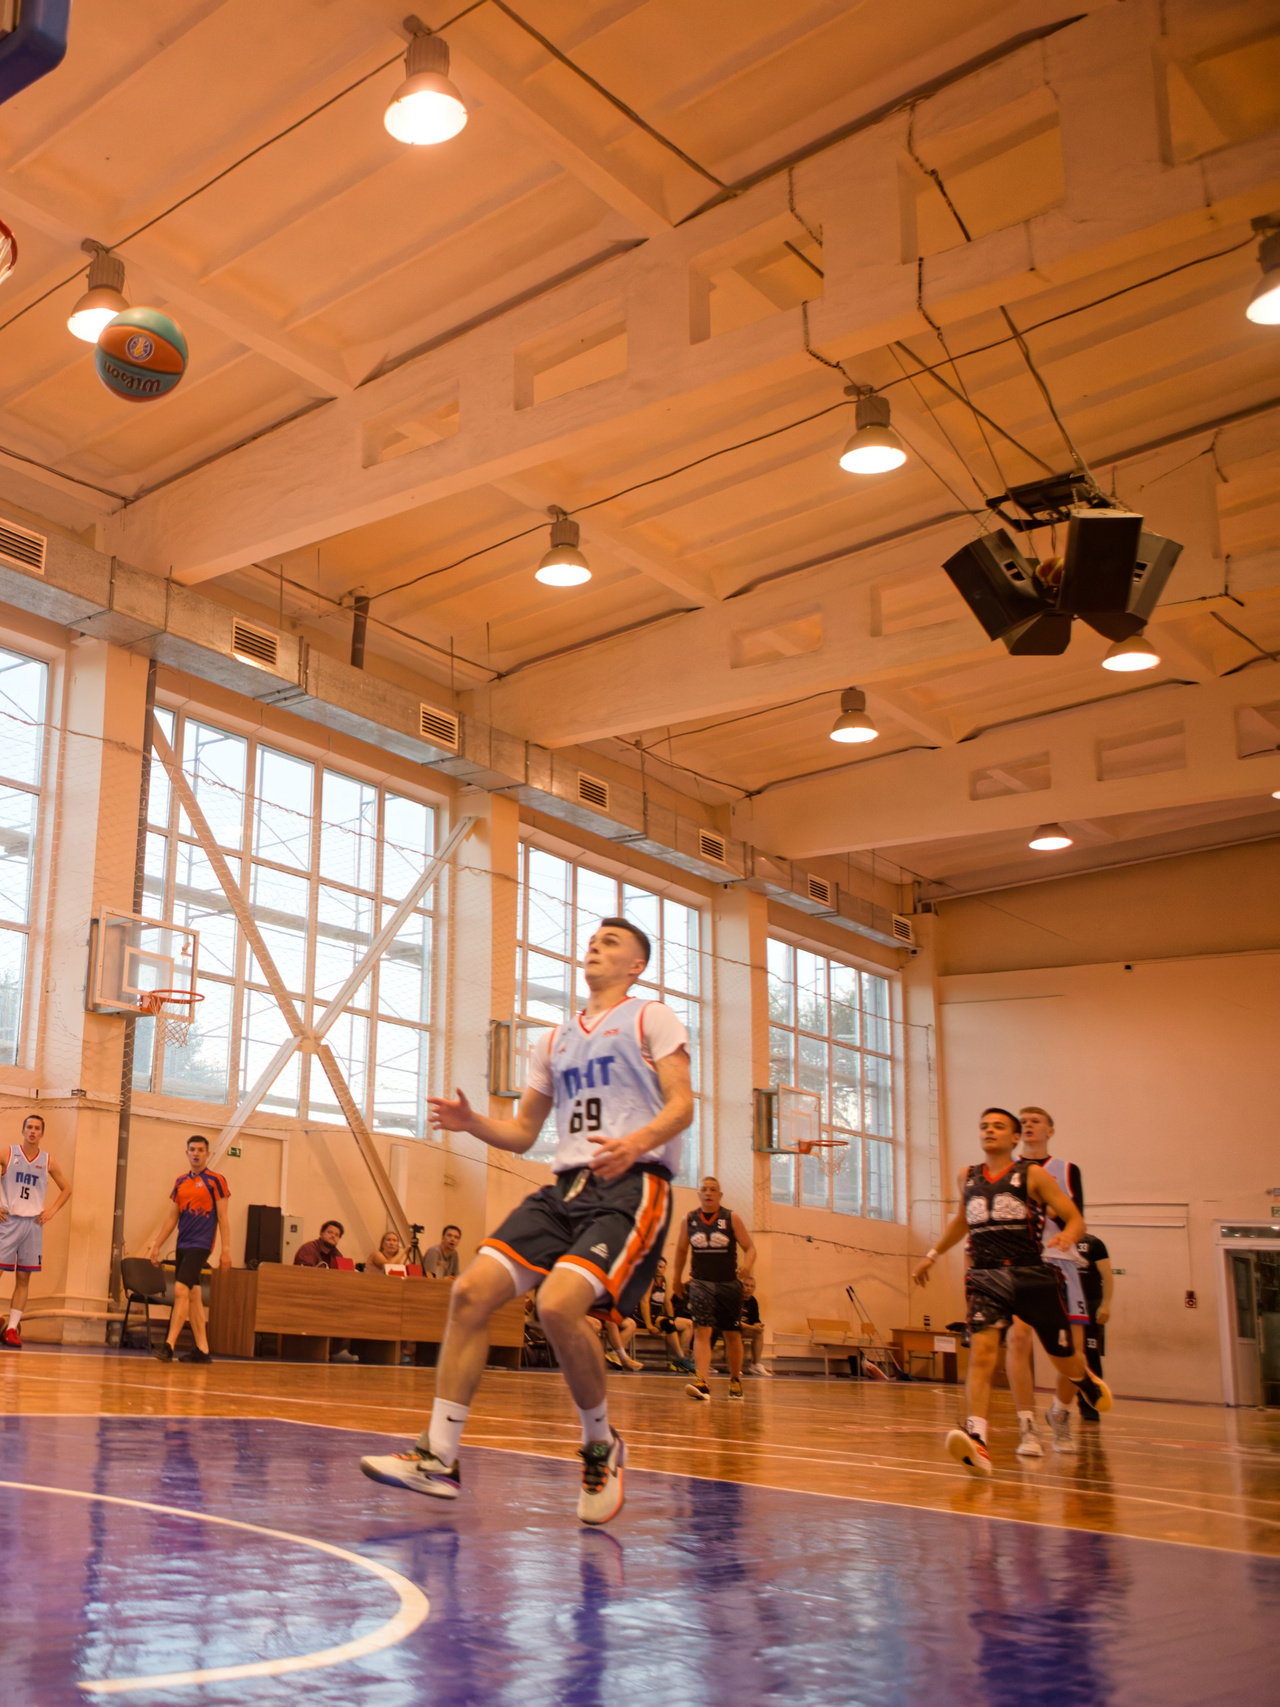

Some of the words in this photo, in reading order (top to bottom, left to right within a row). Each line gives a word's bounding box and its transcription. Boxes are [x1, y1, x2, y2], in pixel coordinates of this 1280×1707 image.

[103, 361, 161, 393] Wilson
[569, 1098, 601, 1134] 69
[20, 1186, 30, 1200] 15
